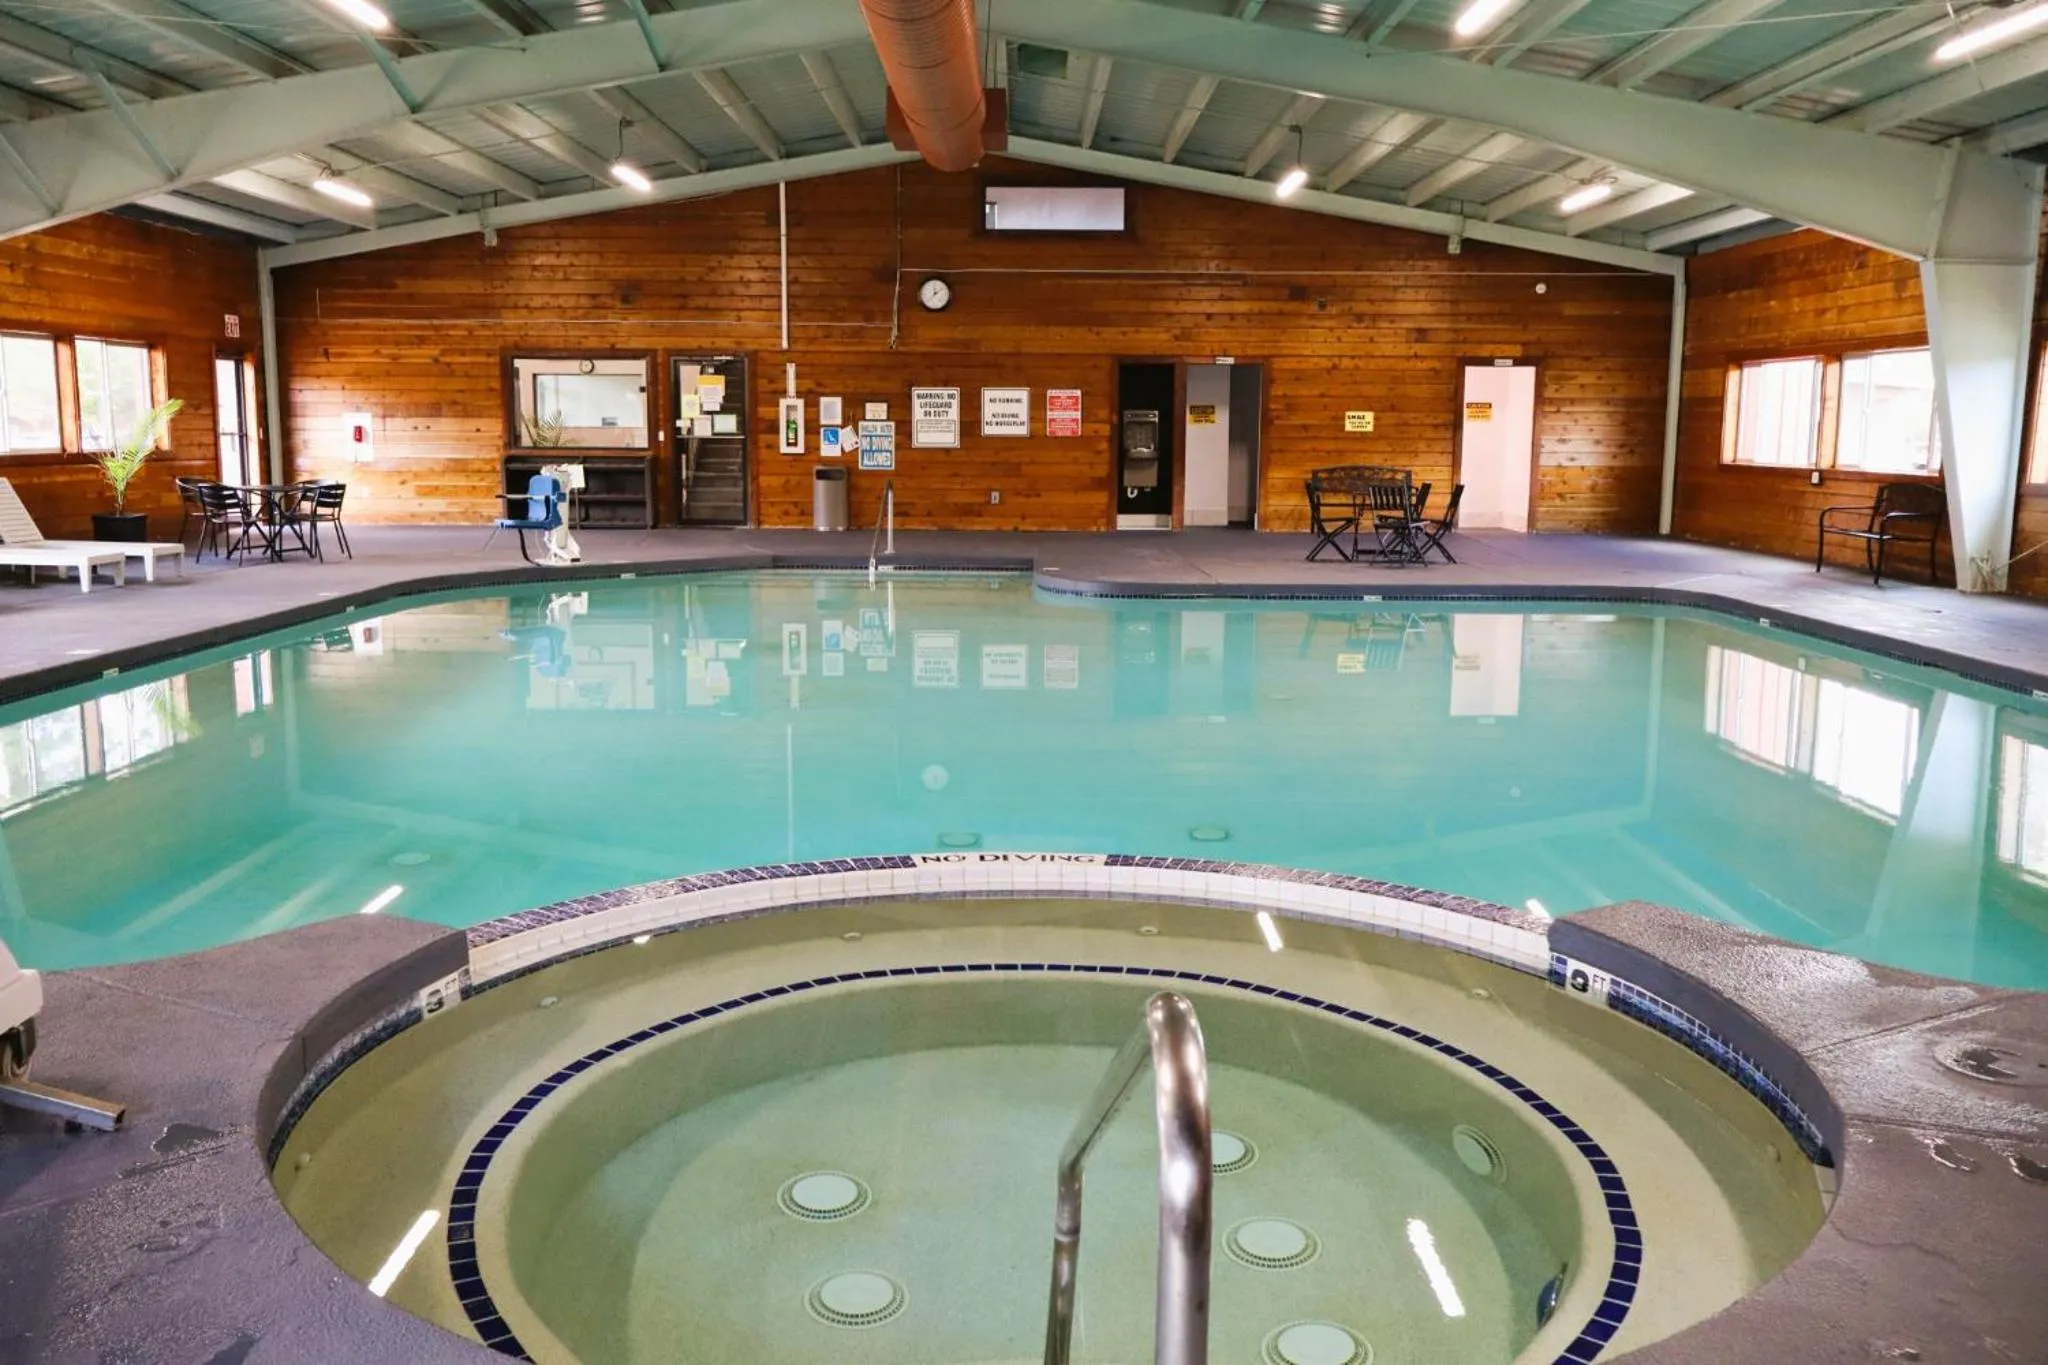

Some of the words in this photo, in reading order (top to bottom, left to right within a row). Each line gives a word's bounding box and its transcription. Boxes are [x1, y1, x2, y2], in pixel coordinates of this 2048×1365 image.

[921, 855, 966, 863] NO
[979, 854, 1095, 863] DIVING
[1592, 974, 1606, 992] FT
